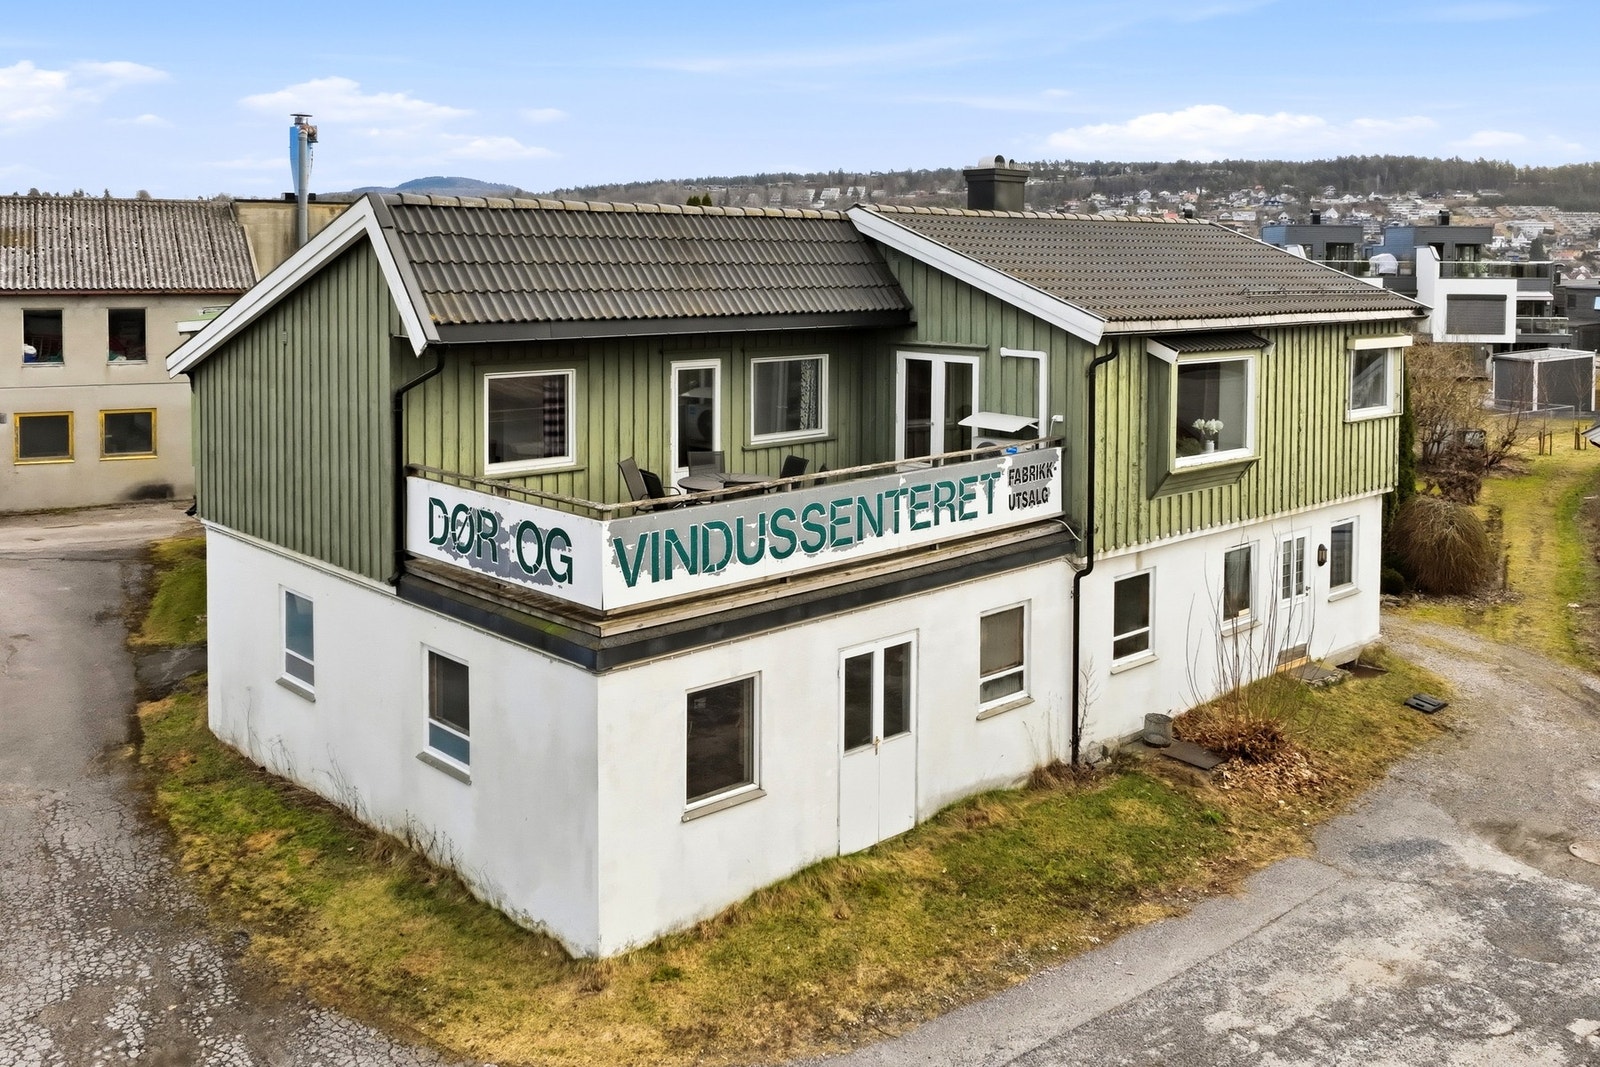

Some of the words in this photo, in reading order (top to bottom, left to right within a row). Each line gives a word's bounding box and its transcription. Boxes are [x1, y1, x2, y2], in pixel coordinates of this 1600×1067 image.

[429, 497, 498, 563] DØR
[516, 520, 573, 585] OG
[613, 471, 1001, 588] VINDUSSENTERET
[1009, 487, 1048, 511] UTSALG
